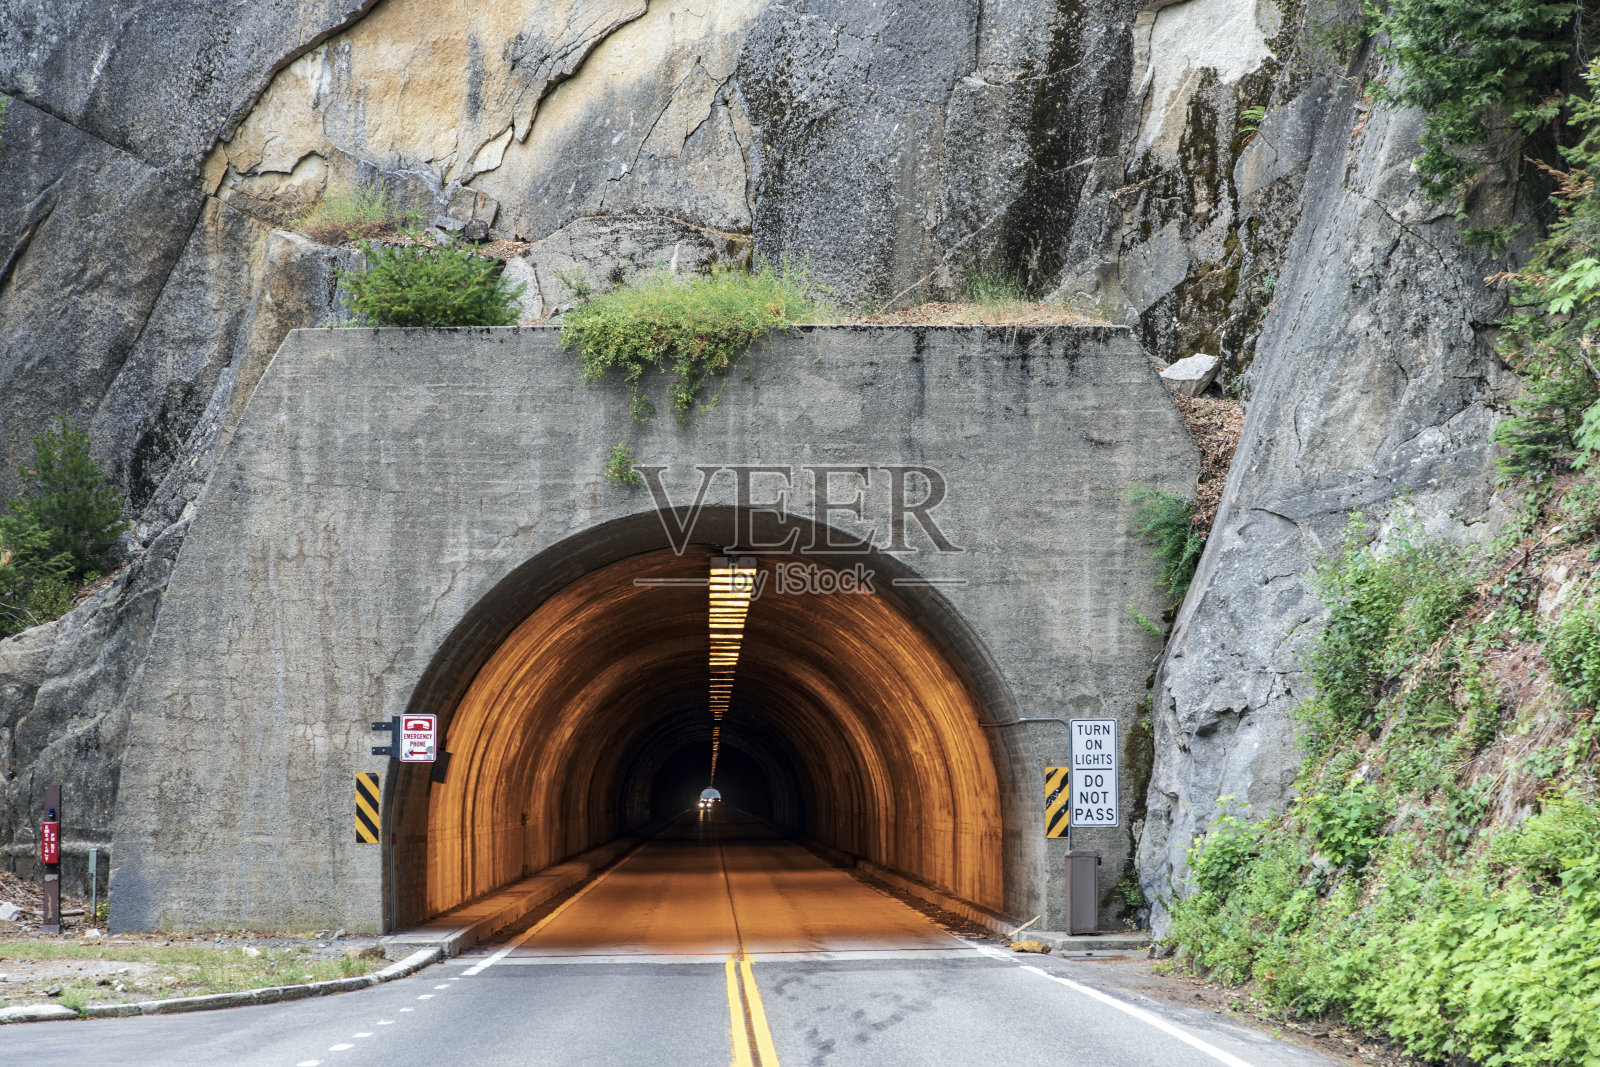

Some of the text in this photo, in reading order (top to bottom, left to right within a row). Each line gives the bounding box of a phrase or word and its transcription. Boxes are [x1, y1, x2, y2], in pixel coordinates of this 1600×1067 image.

[1077, 724, 1110, 736] TURN
[409, 740, 426, 748] PHONE
[1085, 739, 1102, 750] ON
[1075, 754, 1112, 765] LIGHTS
[1084, 775, 1104, 787] DO
[1079, 791, 1109, 804] NOT
[1075, 808, 1114, 821] PASS
